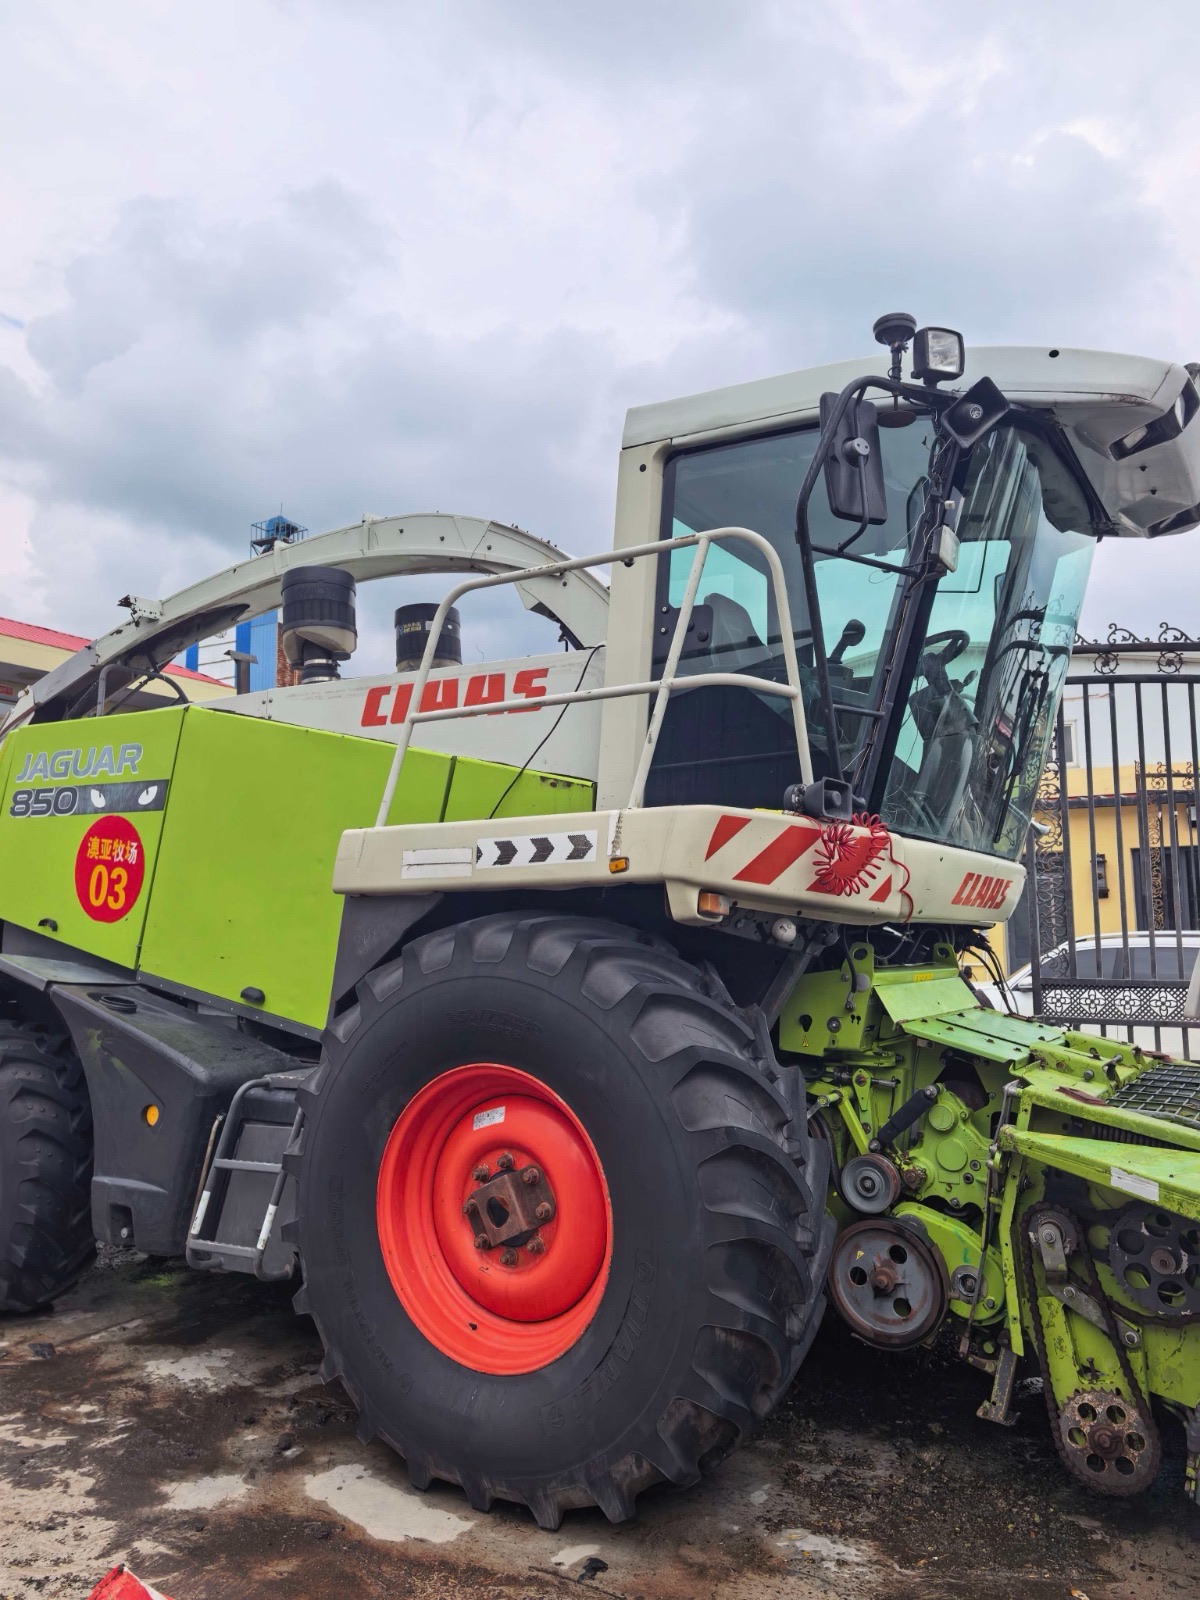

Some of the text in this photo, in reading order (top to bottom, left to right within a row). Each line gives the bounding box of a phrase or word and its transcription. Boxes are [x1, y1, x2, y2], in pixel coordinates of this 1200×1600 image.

[361, 668, 549, 727] CLAAS
[16, 743, 143, 783] JAGUAR
[10, 786, 79, 818] 850
[87, 836, 138, 865] 澳亚牧场
[89, 864, 128, 910] 03
[951, 872, 1013, 909] CLAAS
